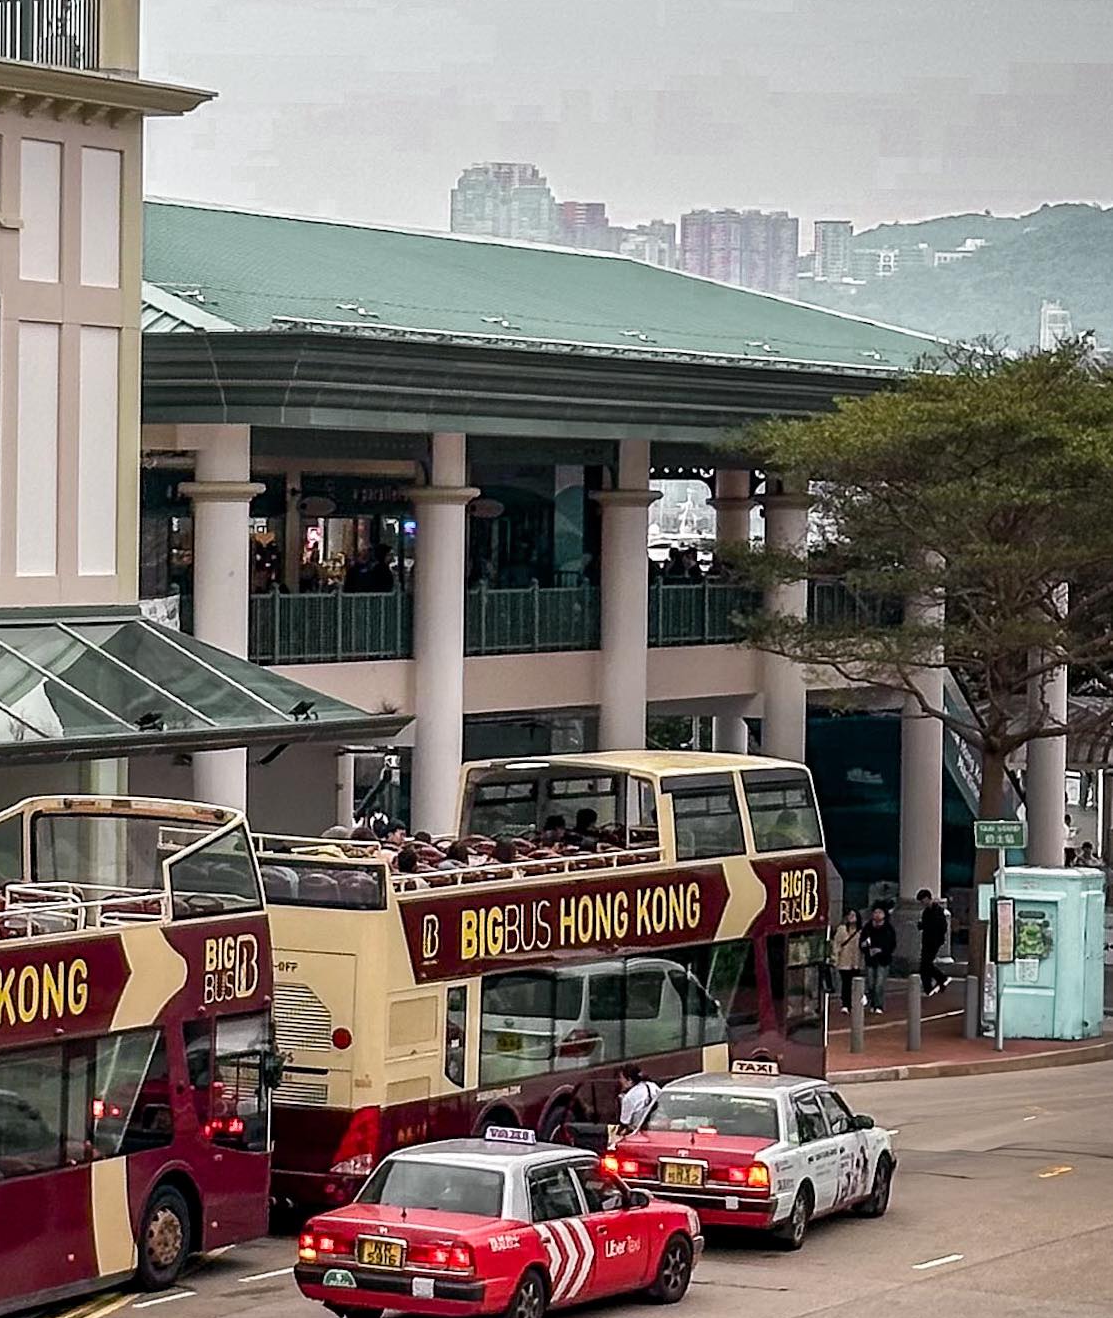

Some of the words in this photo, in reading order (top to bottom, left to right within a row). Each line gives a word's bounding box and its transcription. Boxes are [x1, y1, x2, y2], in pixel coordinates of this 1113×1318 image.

[780, 870, 802, 899] BIG
[461, 899, 552, 960] BIGBUS
[560, 891, 629, 946] HONG
[637, 882, 700, 936] KONG
[205, 936, 236, 972] BIG
[204, 971, 235, 1004] BUS
[737, 1062, 773, 1073] TAXI
